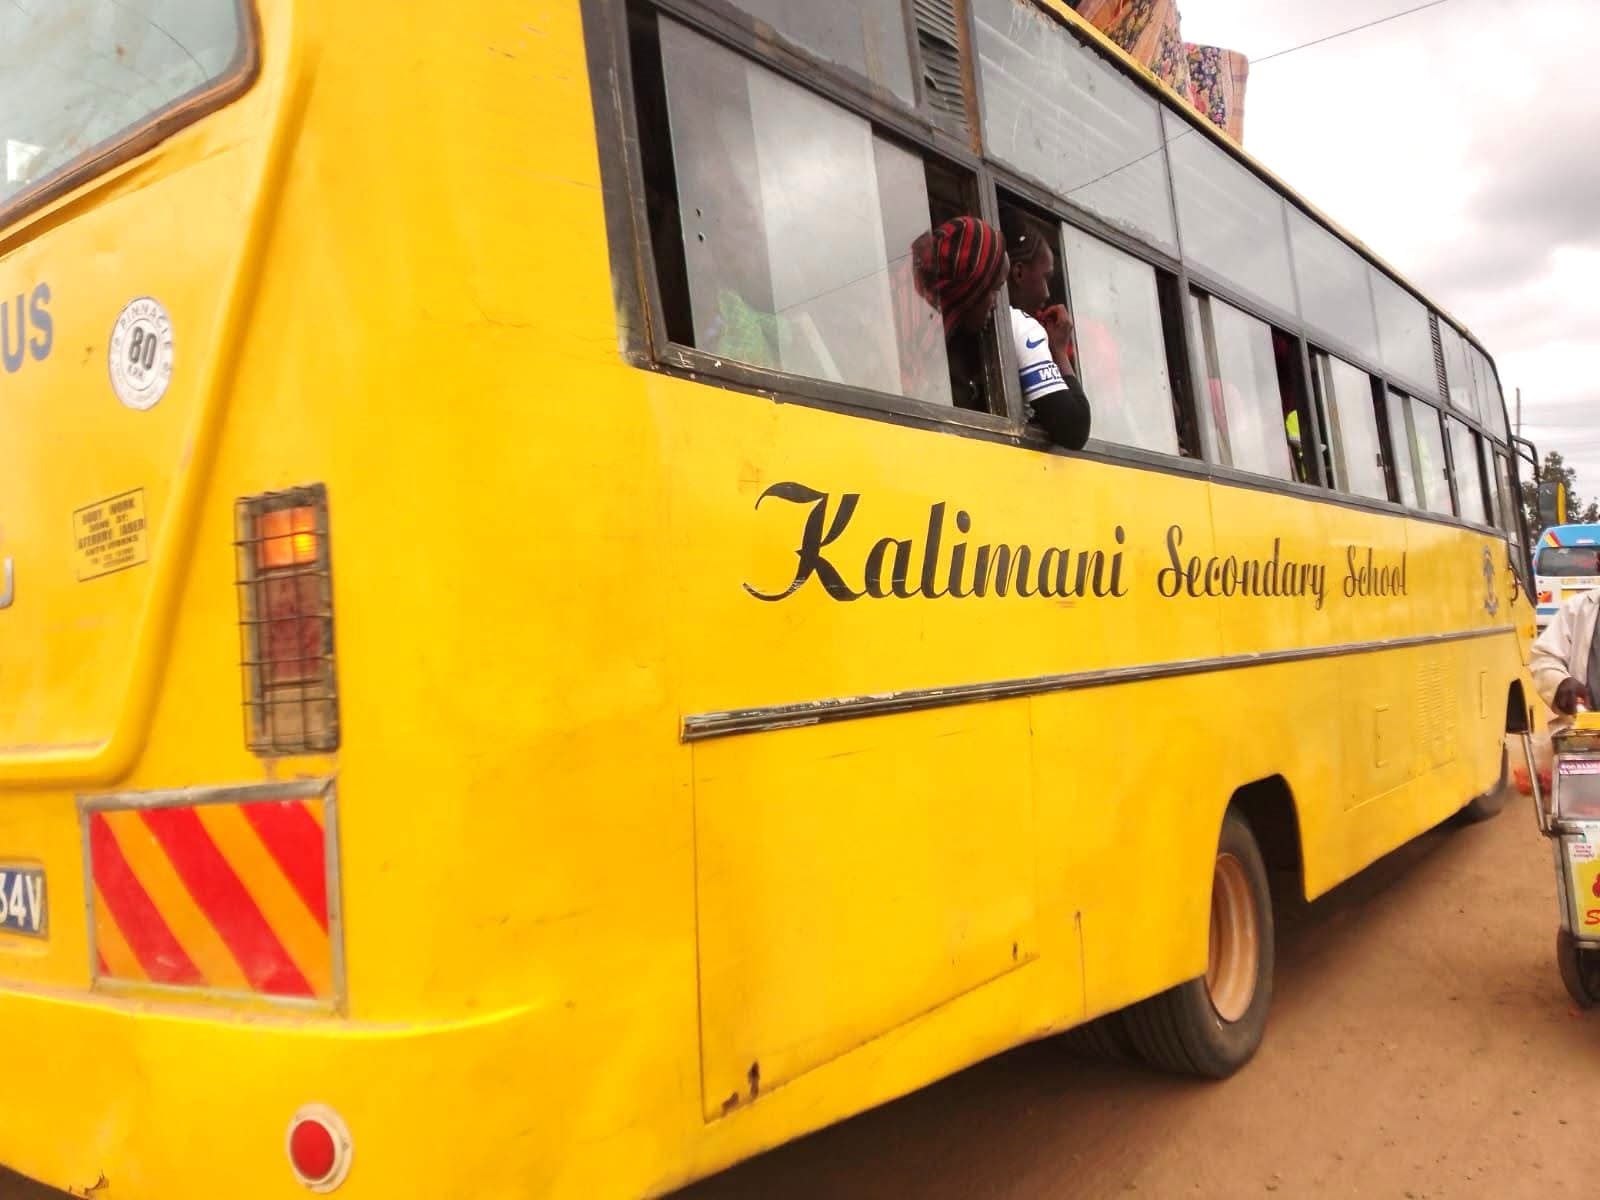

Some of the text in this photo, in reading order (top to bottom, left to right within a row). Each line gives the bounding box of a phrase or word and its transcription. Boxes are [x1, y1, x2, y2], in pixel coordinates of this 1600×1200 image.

[0, 282, 53, 373] US
[128, 326, 157, 370] 80
[742, 481, 1409, 611] Kalimani Secondary School
